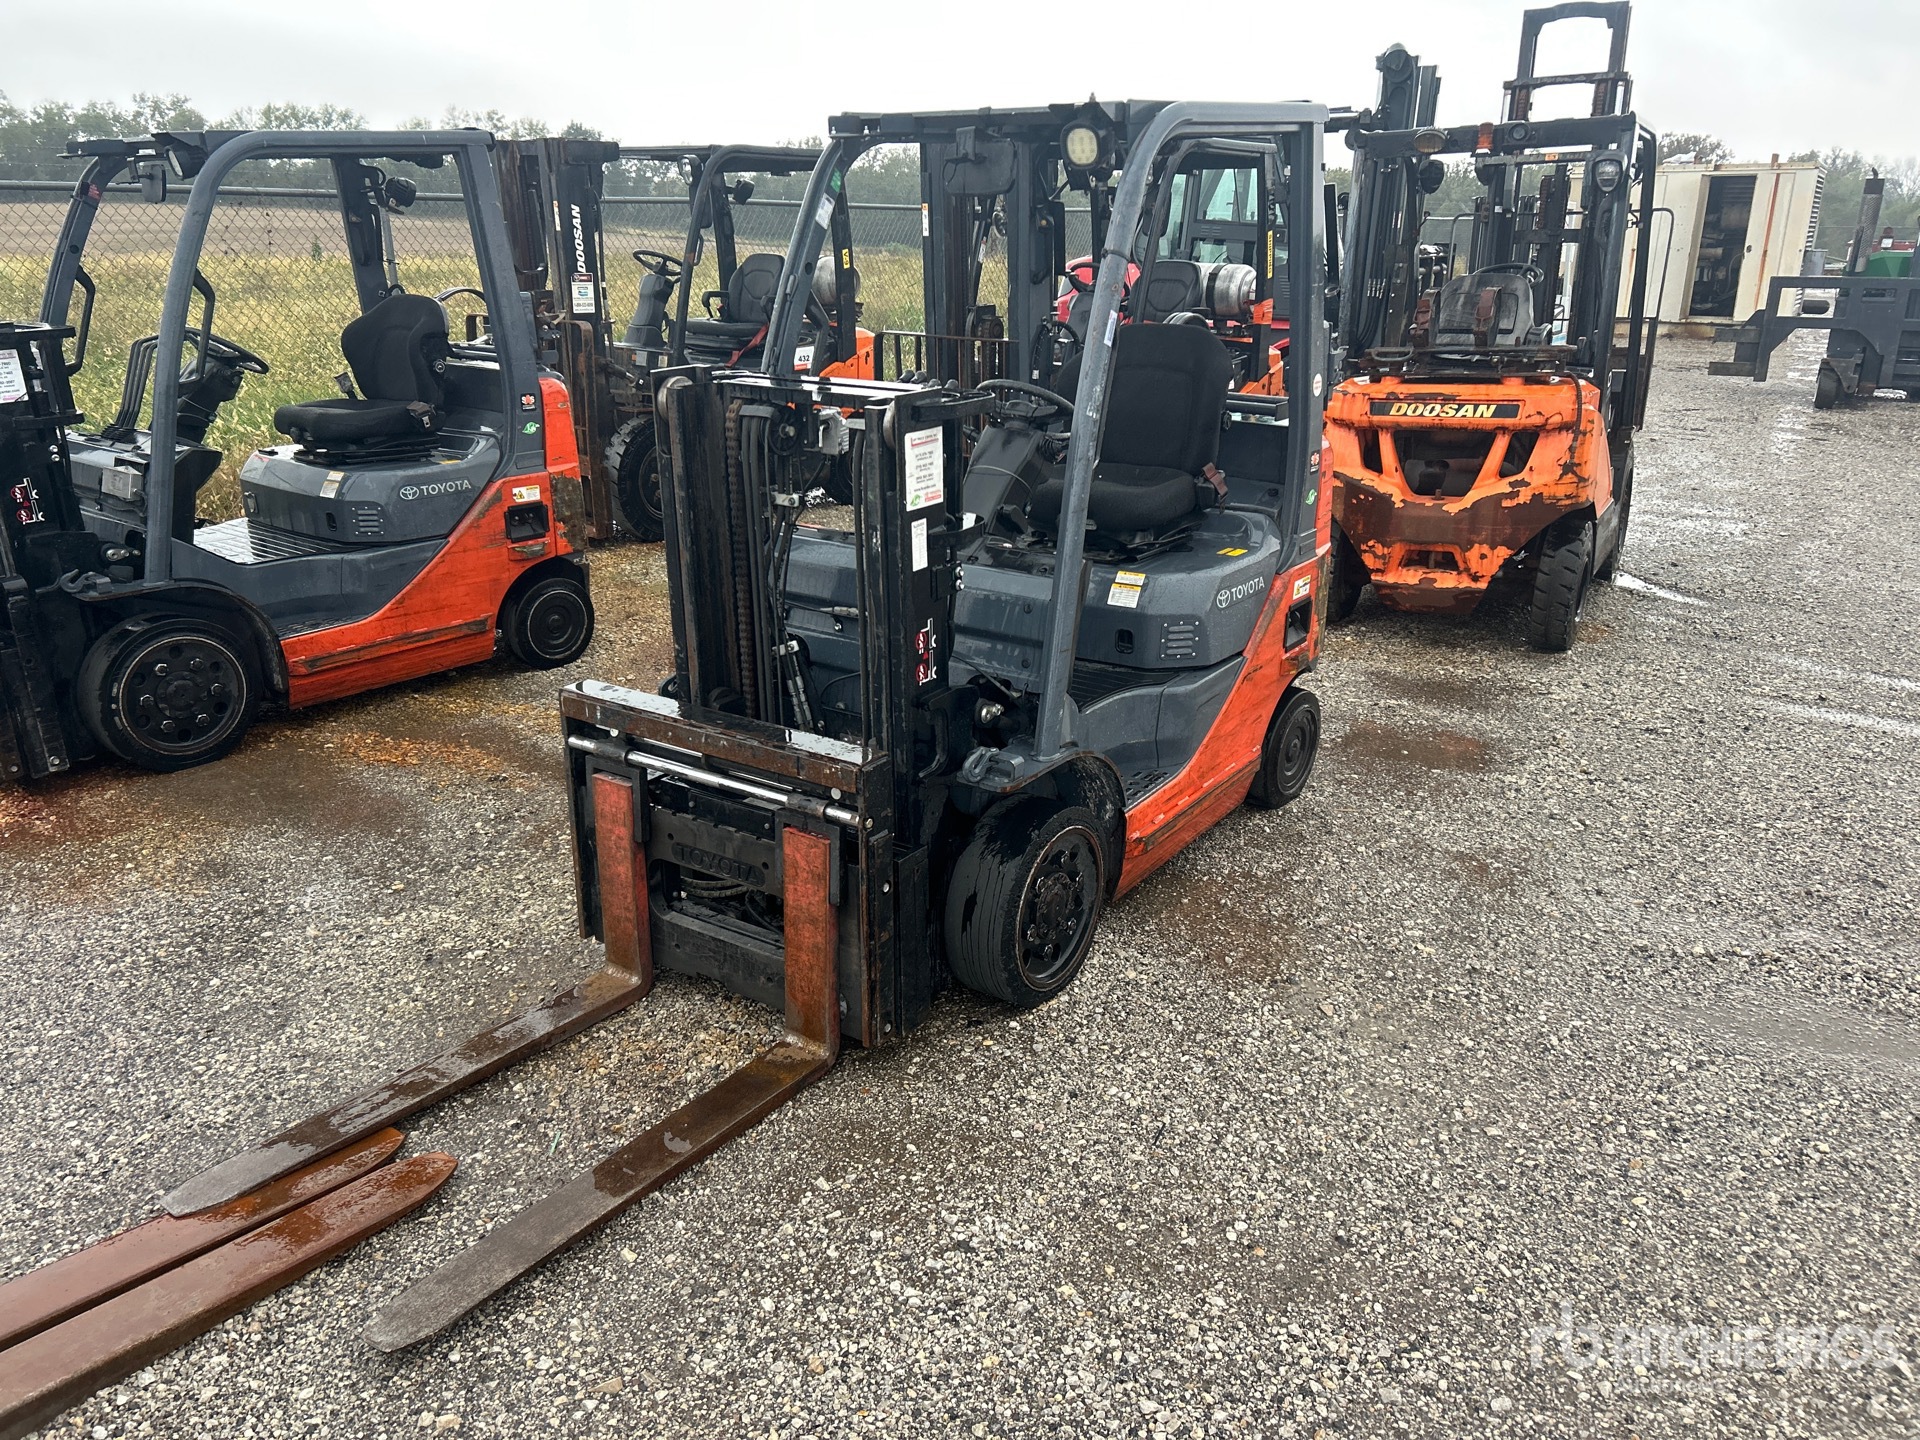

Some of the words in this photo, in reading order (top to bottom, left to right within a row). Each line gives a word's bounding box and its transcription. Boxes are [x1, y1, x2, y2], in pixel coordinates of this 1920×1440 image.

[571, 203, 586, 273] DOOSAN
[1389, 402, 1498, 418] DOOSAN
[420, 479, 472, 496] TOYOTA
[1231, 576, 1265, 601] TOYOTA
[676, 844, 760, 883] TOYOTA
